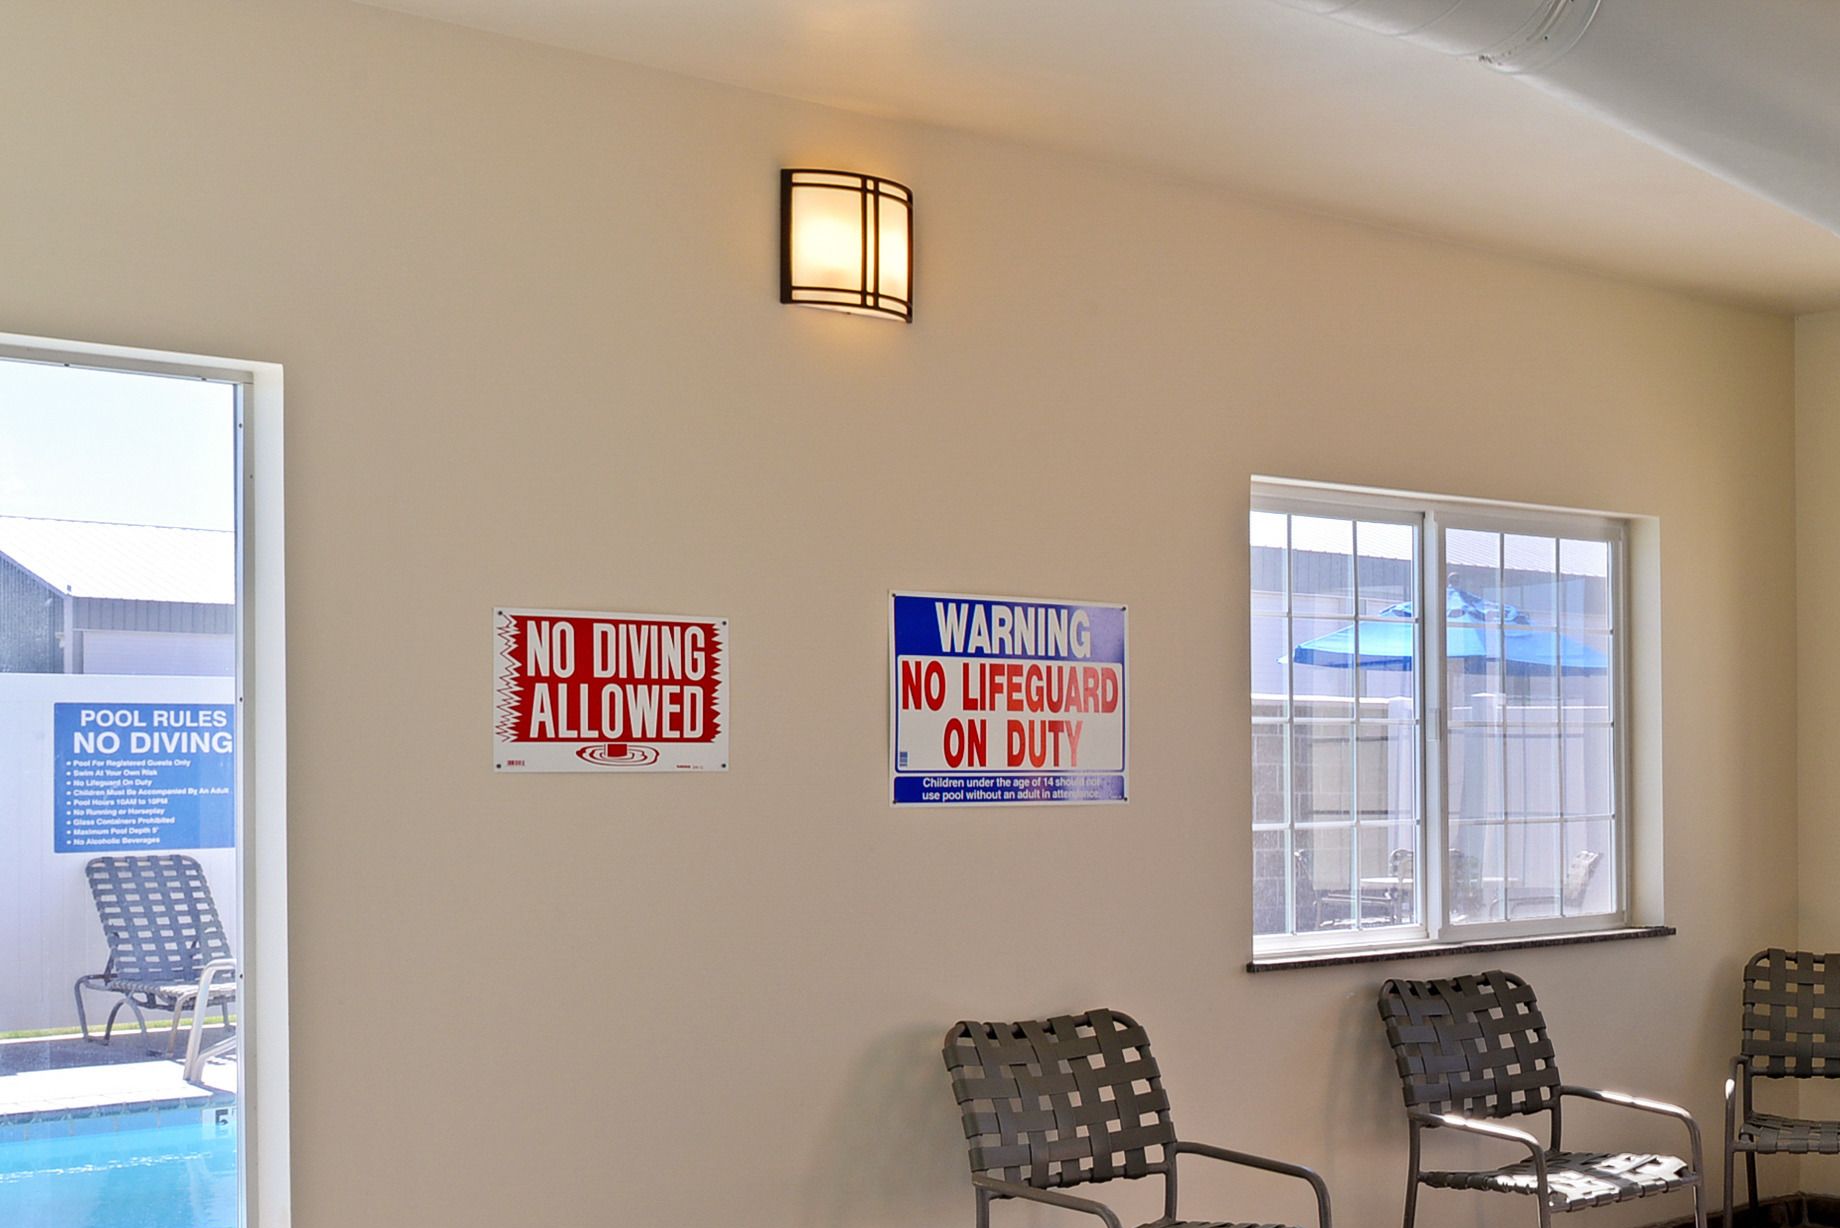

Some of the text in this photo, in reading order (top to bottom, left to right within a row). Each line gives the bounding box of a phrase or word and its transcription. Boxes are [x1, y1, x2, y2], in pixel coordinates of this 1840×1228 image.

[935, 602, 1091, 658] WARNING
[526, 620, 706, 681] NO DIVING
[902, 660, 1118, 714] NO LIFEGUARD
[529, 683, 704, 739] ALLOWED
[80, 710, 227, 728] POOL RULES
[73, 732, 233, 754] NO DIVING
[943, 718, 1083, 768] ON DUTY
[106, 759, 146, 768] Registered
[174, 759, 191, 767] Only
[86, 779, 121, 787] Lifeguard
[135, 779, 152, 787] Duty
[923, 777, 965, 788] Children
[966, 778, 995, 788] under
[996, 778, 1012, 787] the
[1013, 779, 1030, 790] age
[1031, 778, 1041, 787] of
[1043, 777, 1054, 787] 14
[138, 788, 187, 796] Accompanied
[922, 792, 941, 800] use
[942, 790, 965, 802] pool
[966, 790, 1002, 800] without
[1004, 791, 1015, 800] an
[1016, 789, 1040, 799] adult
[1042, 789, 1051, 798] in
[86, 809, 117, 817] Running
[128, 808, 165, 816] Horseplay
[129, 827, 151, 835] Depth
[122, 837, 160, 845] Beverages
